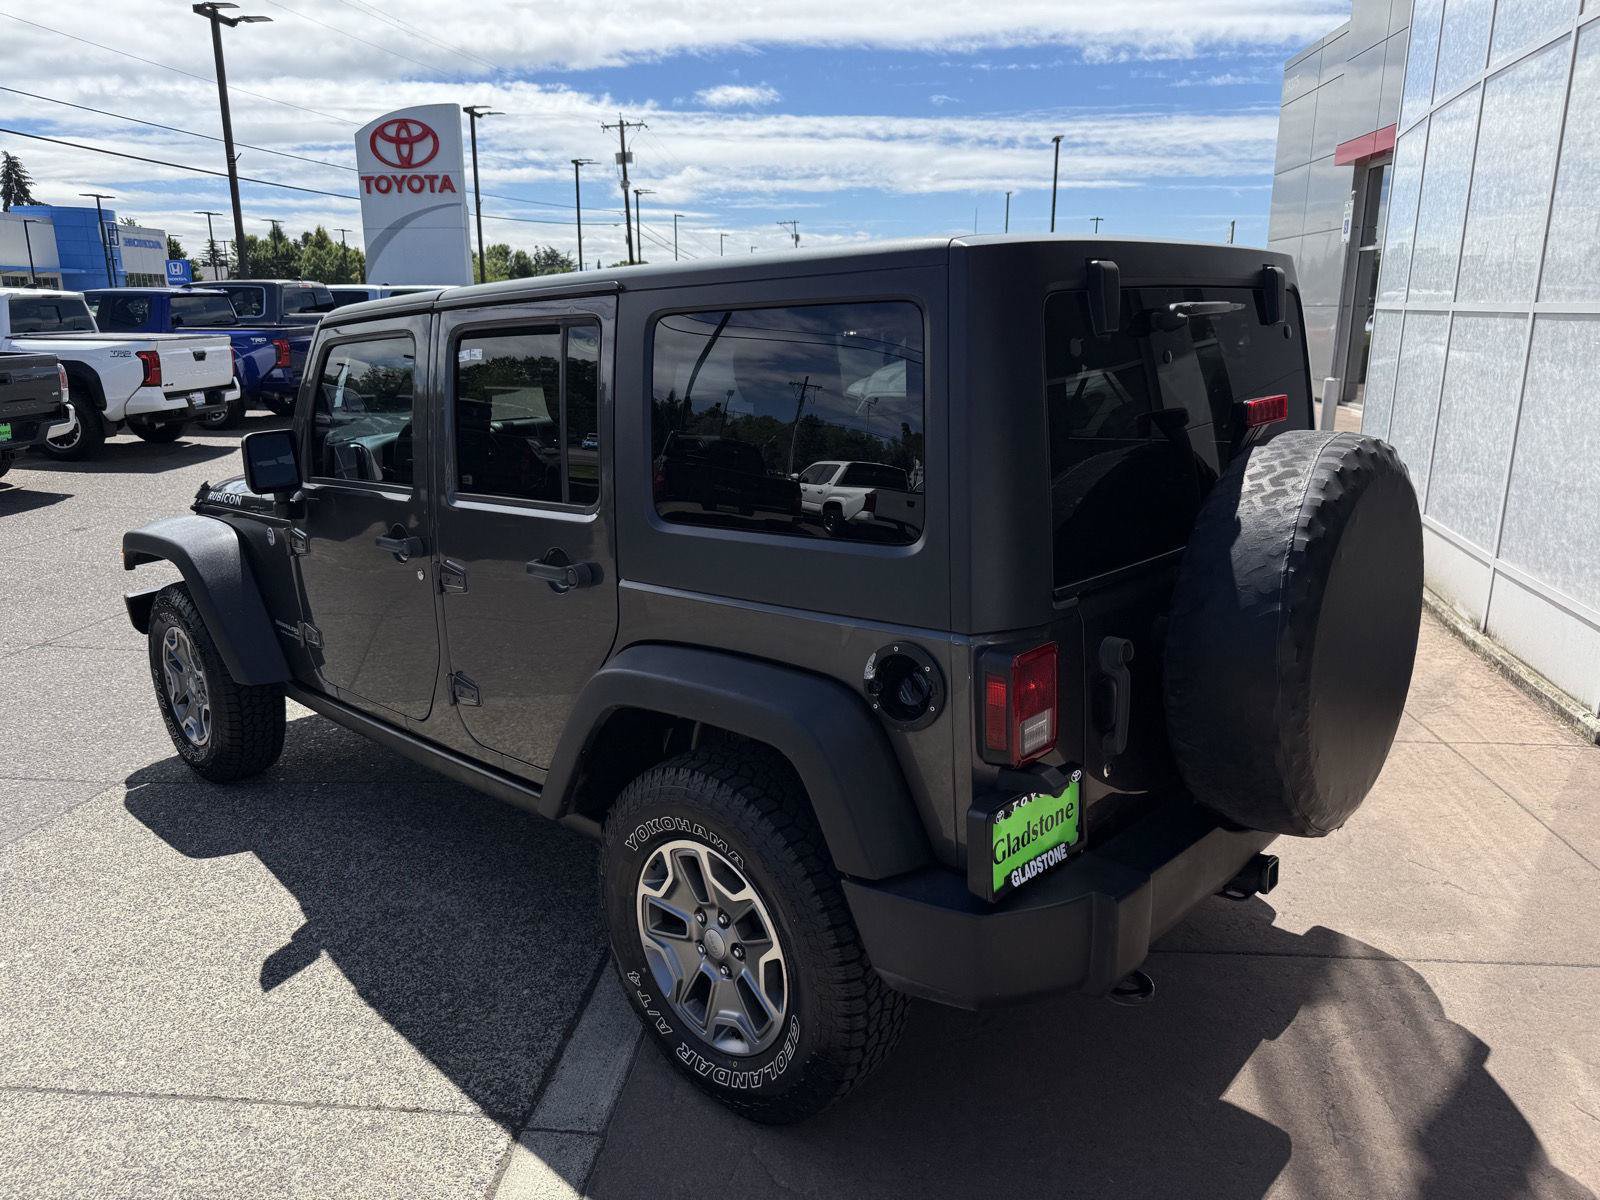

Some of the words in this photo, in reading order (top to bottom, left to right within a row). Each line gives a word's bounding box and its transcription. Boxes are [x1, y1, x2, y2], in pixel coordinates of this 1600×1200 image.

[360, 174, 457, 195] TOYOTA
[207, 491, 243, 506] RUBICON
[624, 816, 744, 871] YOKOHAMA
[993, 802, 1075, 866] Gladstone
[1011, 842, 1068, 888] GLADSTONE
[675, 1014, 800, 1089] GEOLANDAR
